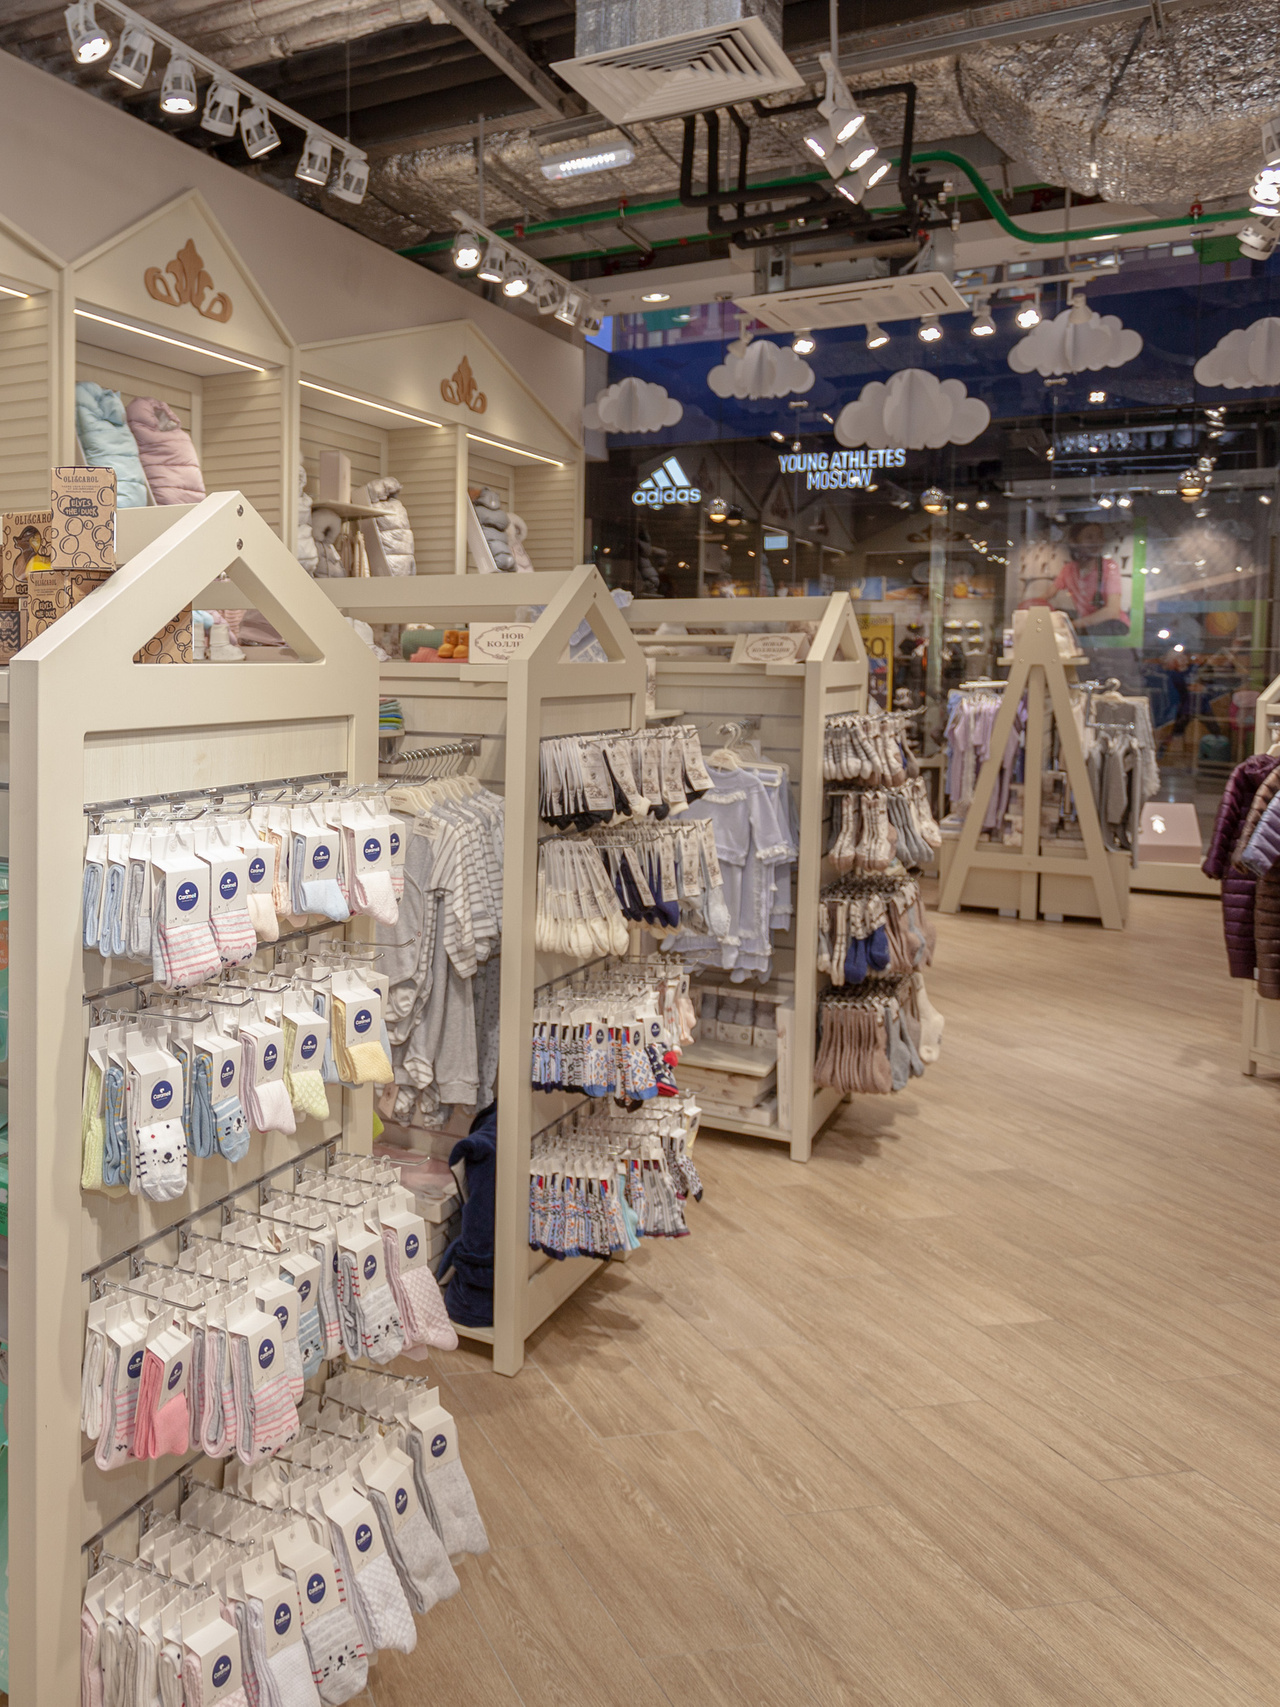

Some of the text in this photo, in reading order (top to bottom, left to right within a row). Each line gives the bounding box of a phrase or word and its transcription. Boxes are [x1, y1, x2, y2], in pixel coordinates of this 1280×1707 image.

[778, 448, 906, 473] YOUNG ATHLETES
[806, 469, 873, 490] MOSCOW
[632, 487, 701, 506] adidas
[14, 513, 52, 525] OLI&CARO
